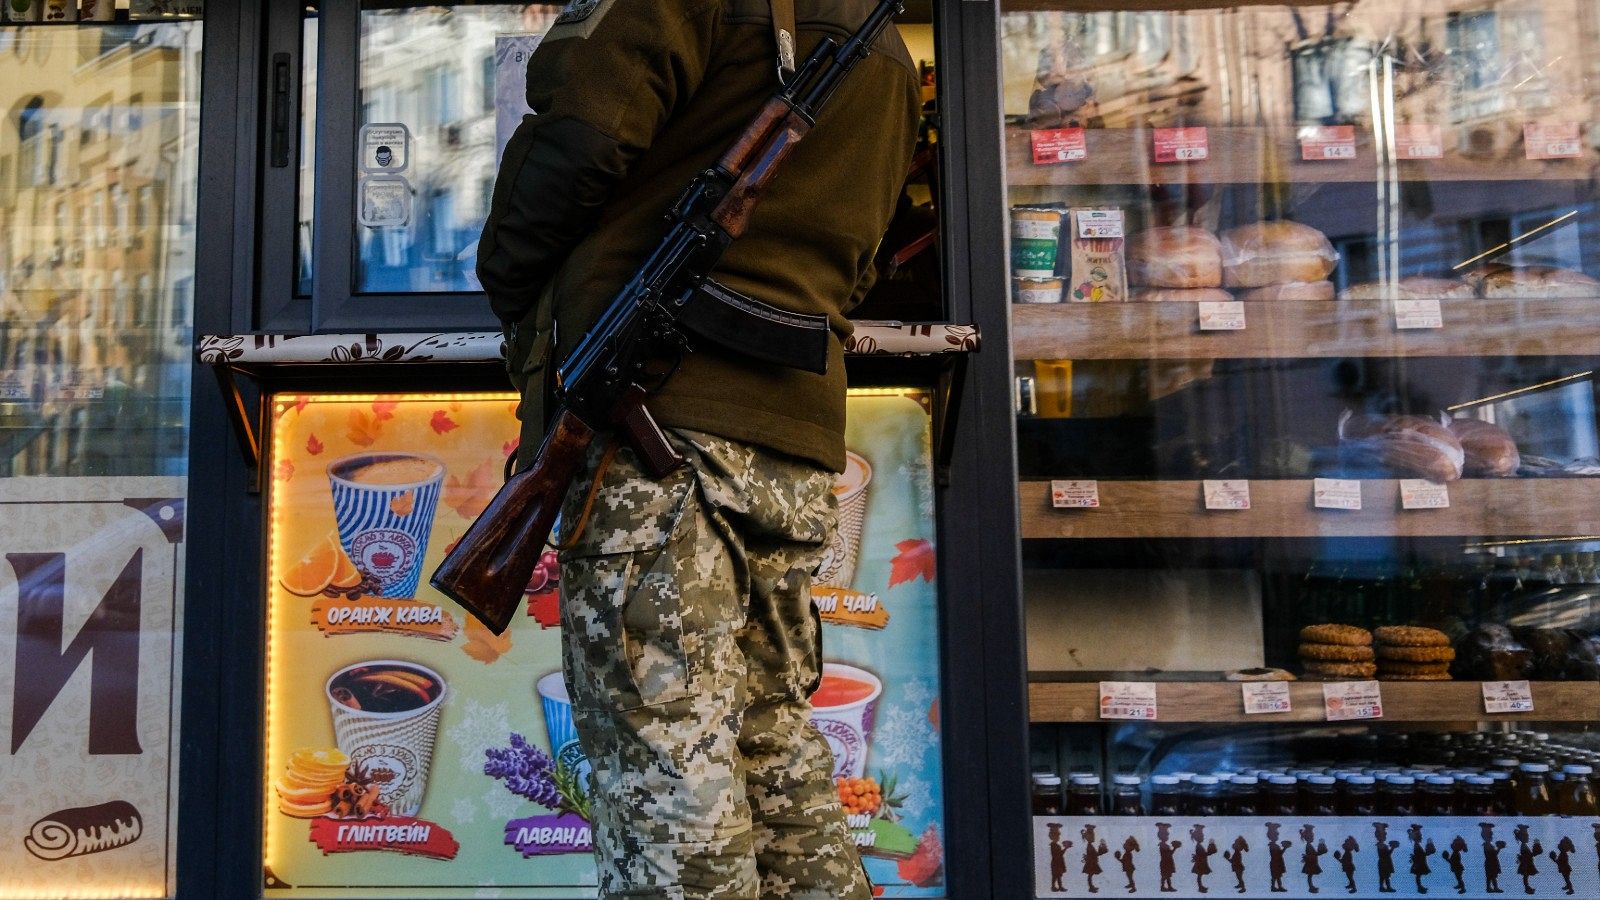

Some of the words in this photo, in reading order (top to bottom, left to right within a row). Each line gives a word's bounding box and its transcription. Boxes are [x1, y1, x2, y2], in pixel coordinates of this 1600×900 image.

[812, 592, 840, 613] ИЙ
[842, 591, 879, 613] ЧАЙ
[327, 605, 394, 625] ОРАНЖ
[396, 605, 443, 624] КАВА
[846, 810, 872, 829] ИЙ
[336, 820, 432, 843] ГЛІНТВЕЙН
[514, 826, 593, 848] ЛАВАНД
